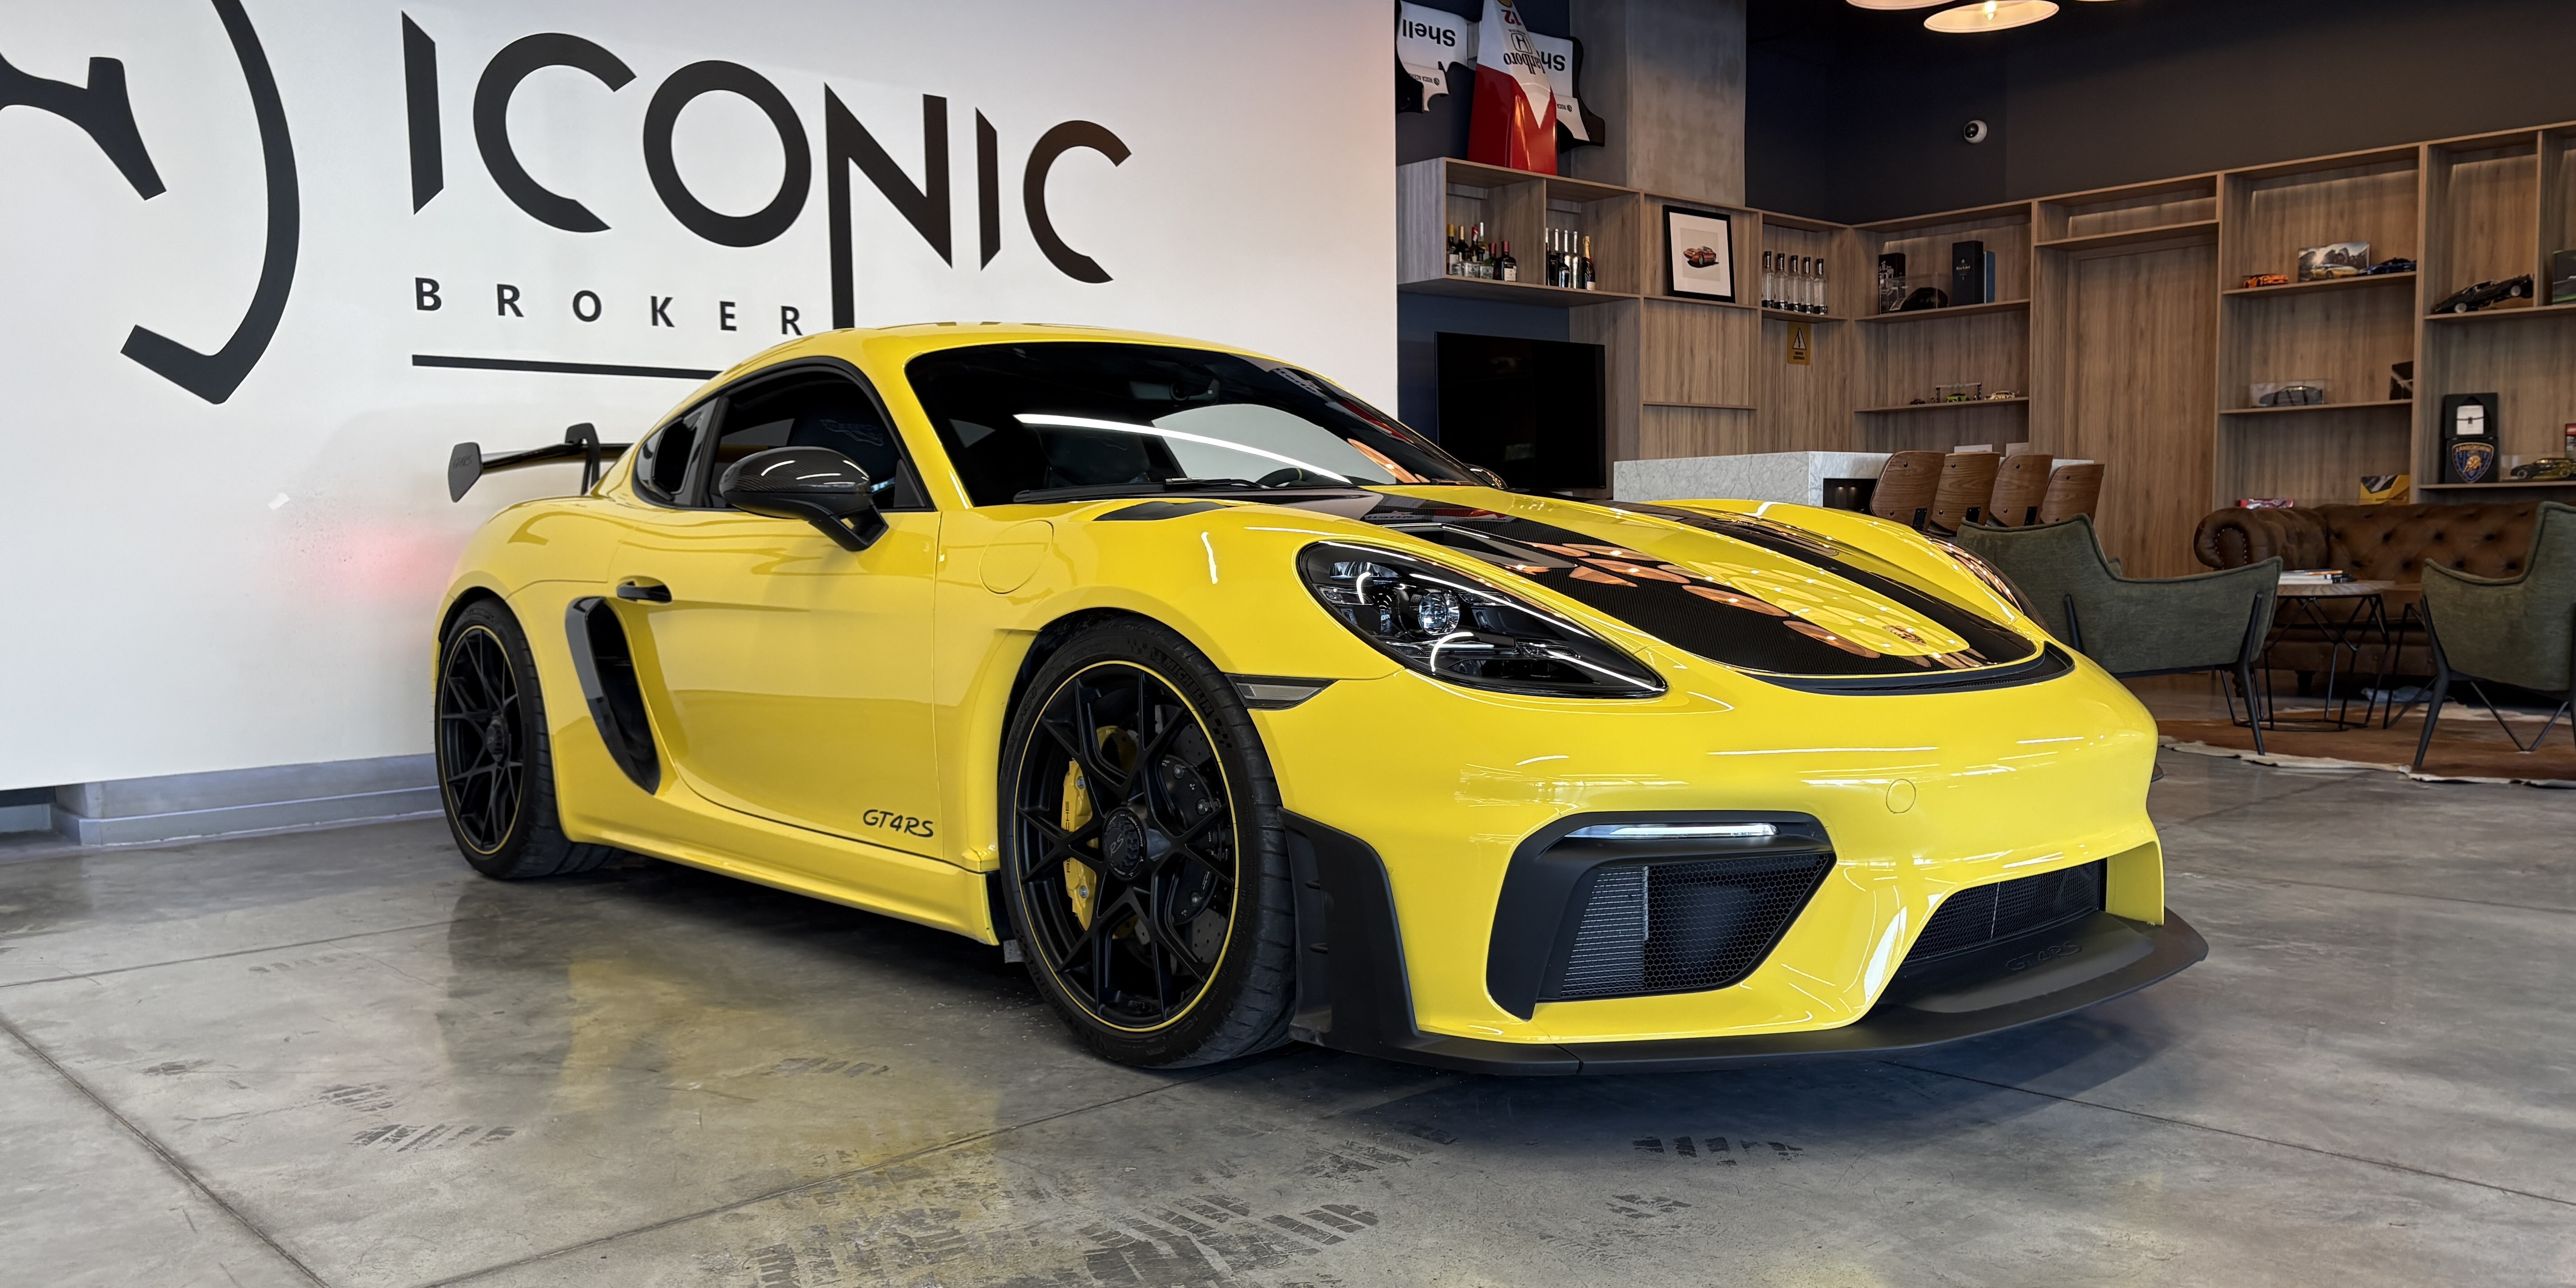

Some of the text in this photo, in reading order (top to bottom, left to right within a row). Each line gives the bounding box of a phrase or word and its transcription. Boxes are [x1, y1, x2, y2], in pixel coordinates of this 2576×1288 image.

[1501, 9, 1522, 26] 12
[1403, 19, 1456, 46] Shell
[401, 10, 1132, 328] ICONIC
[1162, 655, 1215, 716] MICHELIN
[1109, 833, 1124, 858] RS
